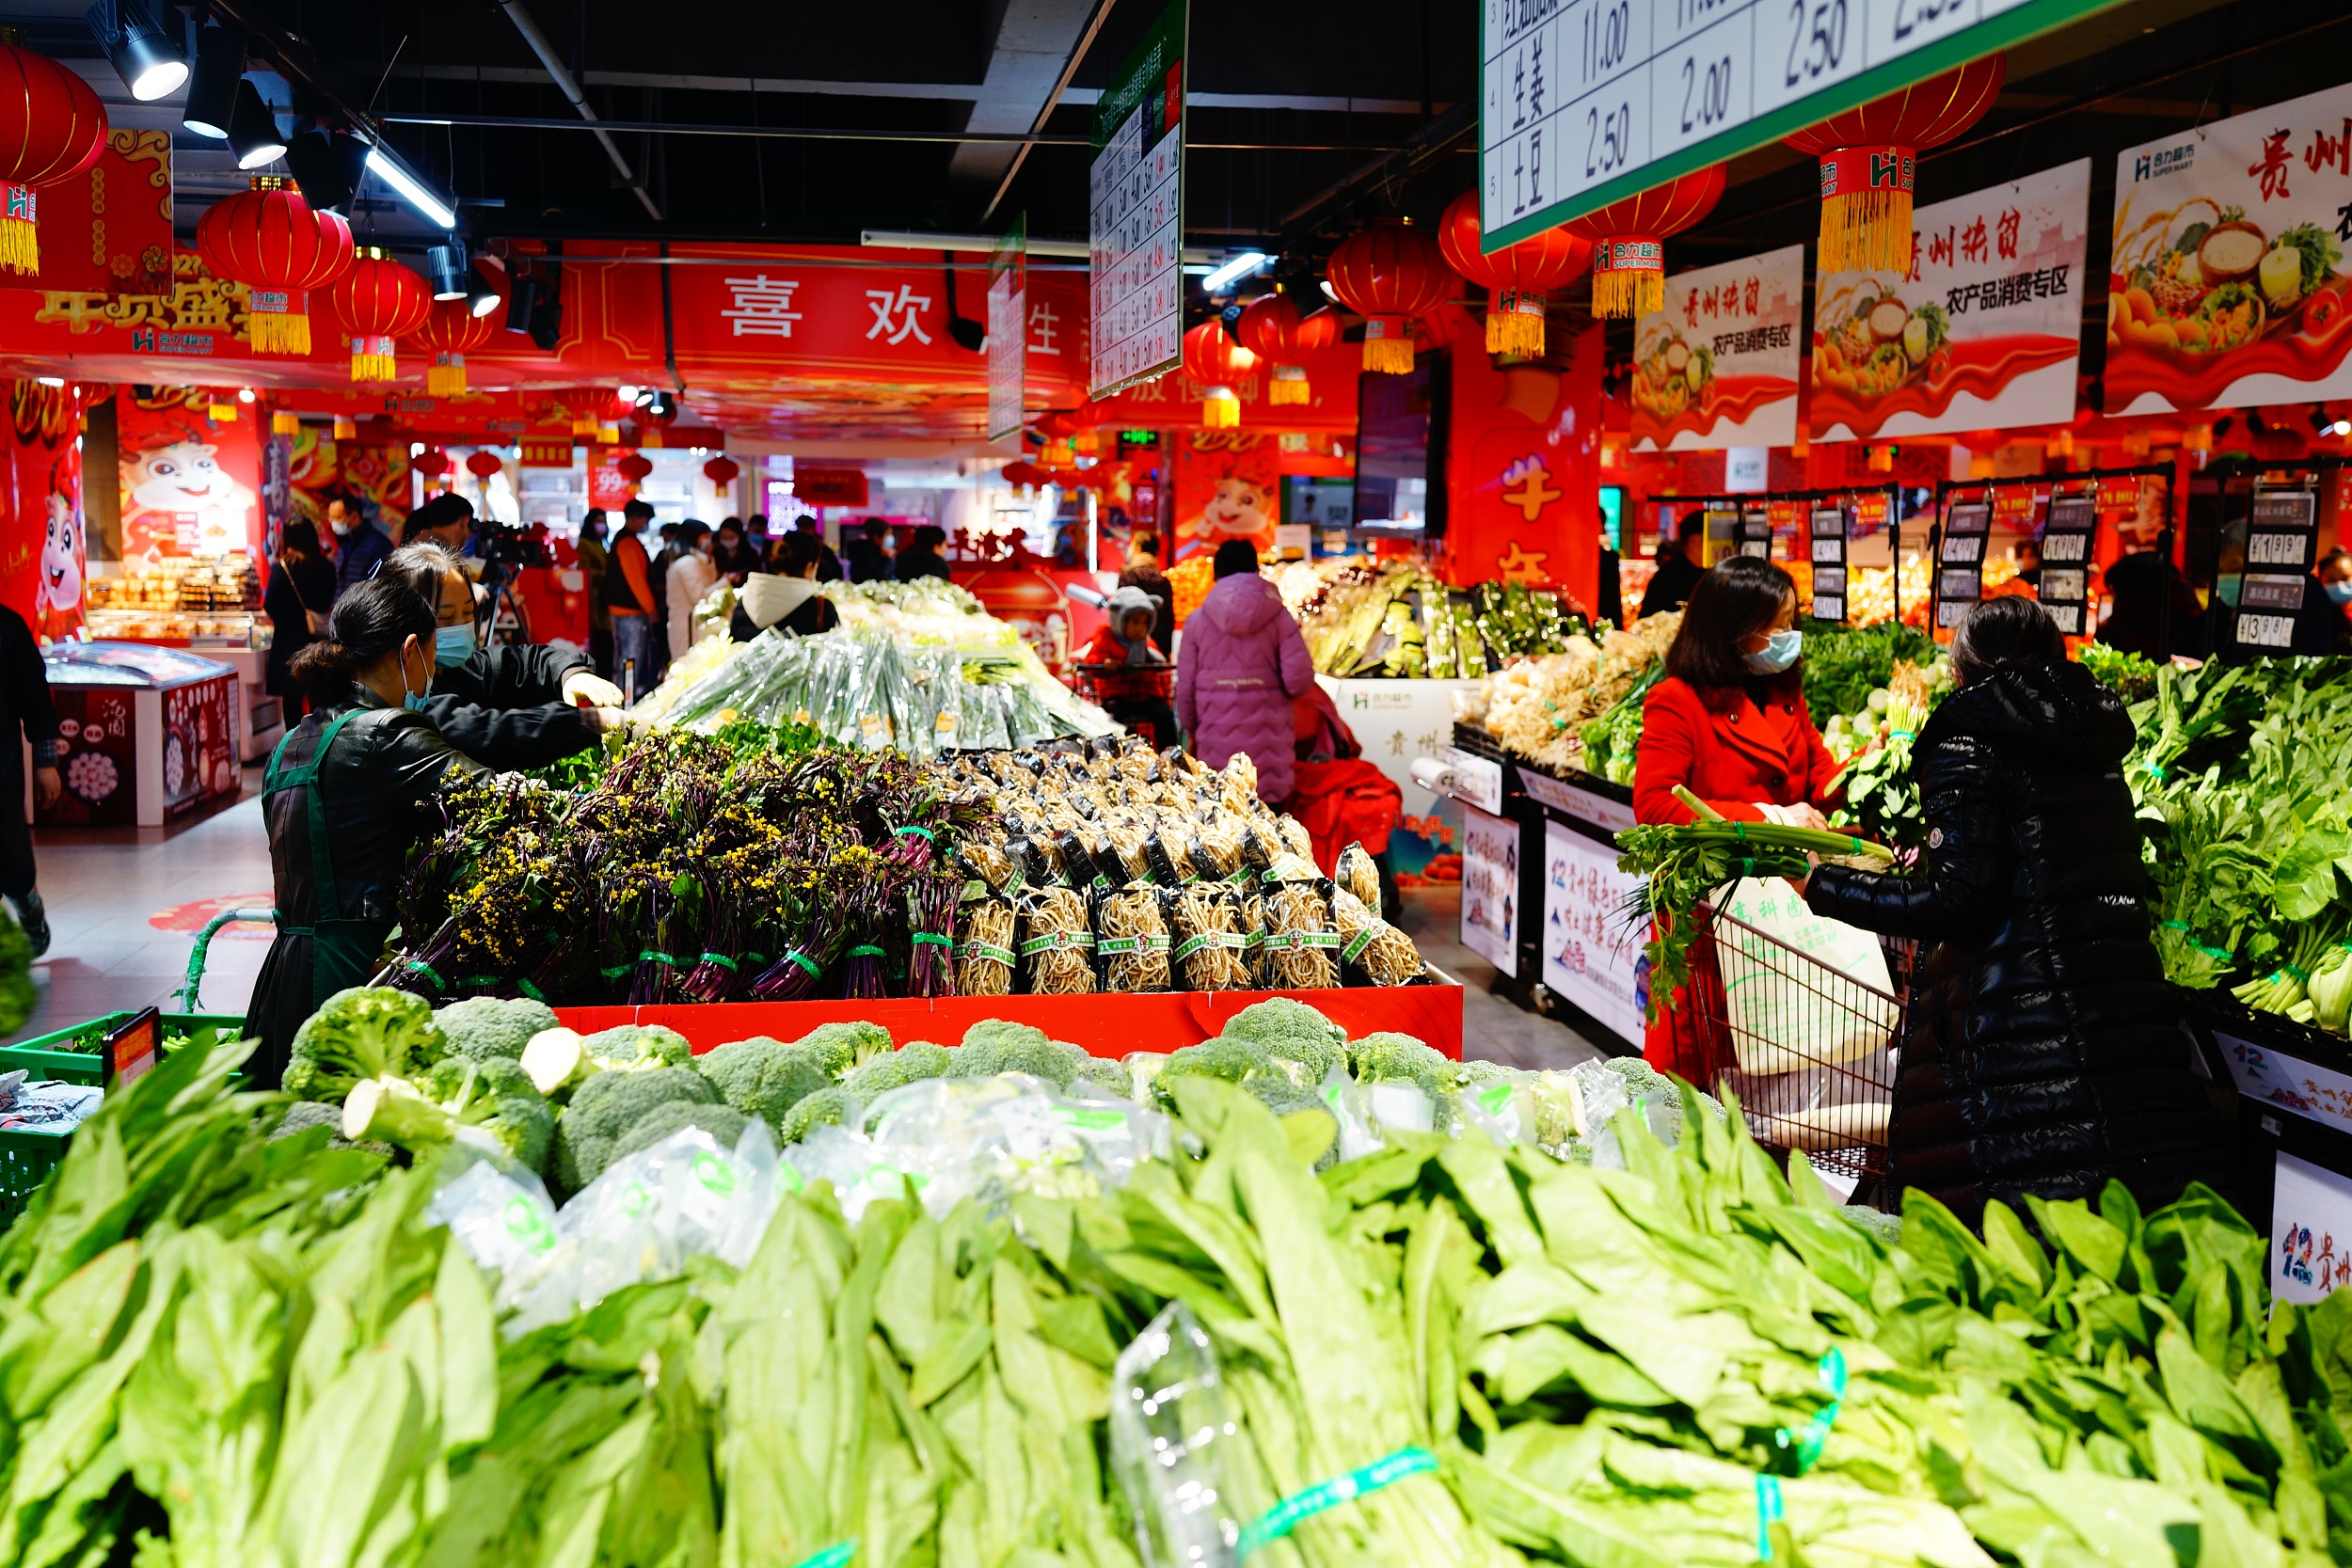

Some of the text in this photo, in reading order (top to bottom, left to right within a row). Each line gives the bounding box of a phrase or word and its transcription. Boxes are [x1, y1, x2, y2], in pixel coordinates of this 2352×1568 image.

[1582, 0, 1629, 85] 11.00
[1785, 0, 1847, 87] 2.50
[1513, 29, 1546, 130] 生姜
[1681, 54, 1731, 135] 2.00
[1513, 128, 1544, 216] 土豆
[1585, 101, 1629, 179] 2.50
[2153, 144, 2195, 166] 合力超市
[1613, 243, 1661, 259] 合力超市
[1613, 259, 1641, 269] SUPER
[1946, 264, 2070, 316] 农产品消费专区
[158, 332, 215, 347] 合力超市
[1712, 324, 1792, 356] 农产品消费专区
[2281, 1222, 2313, 1286] 12
